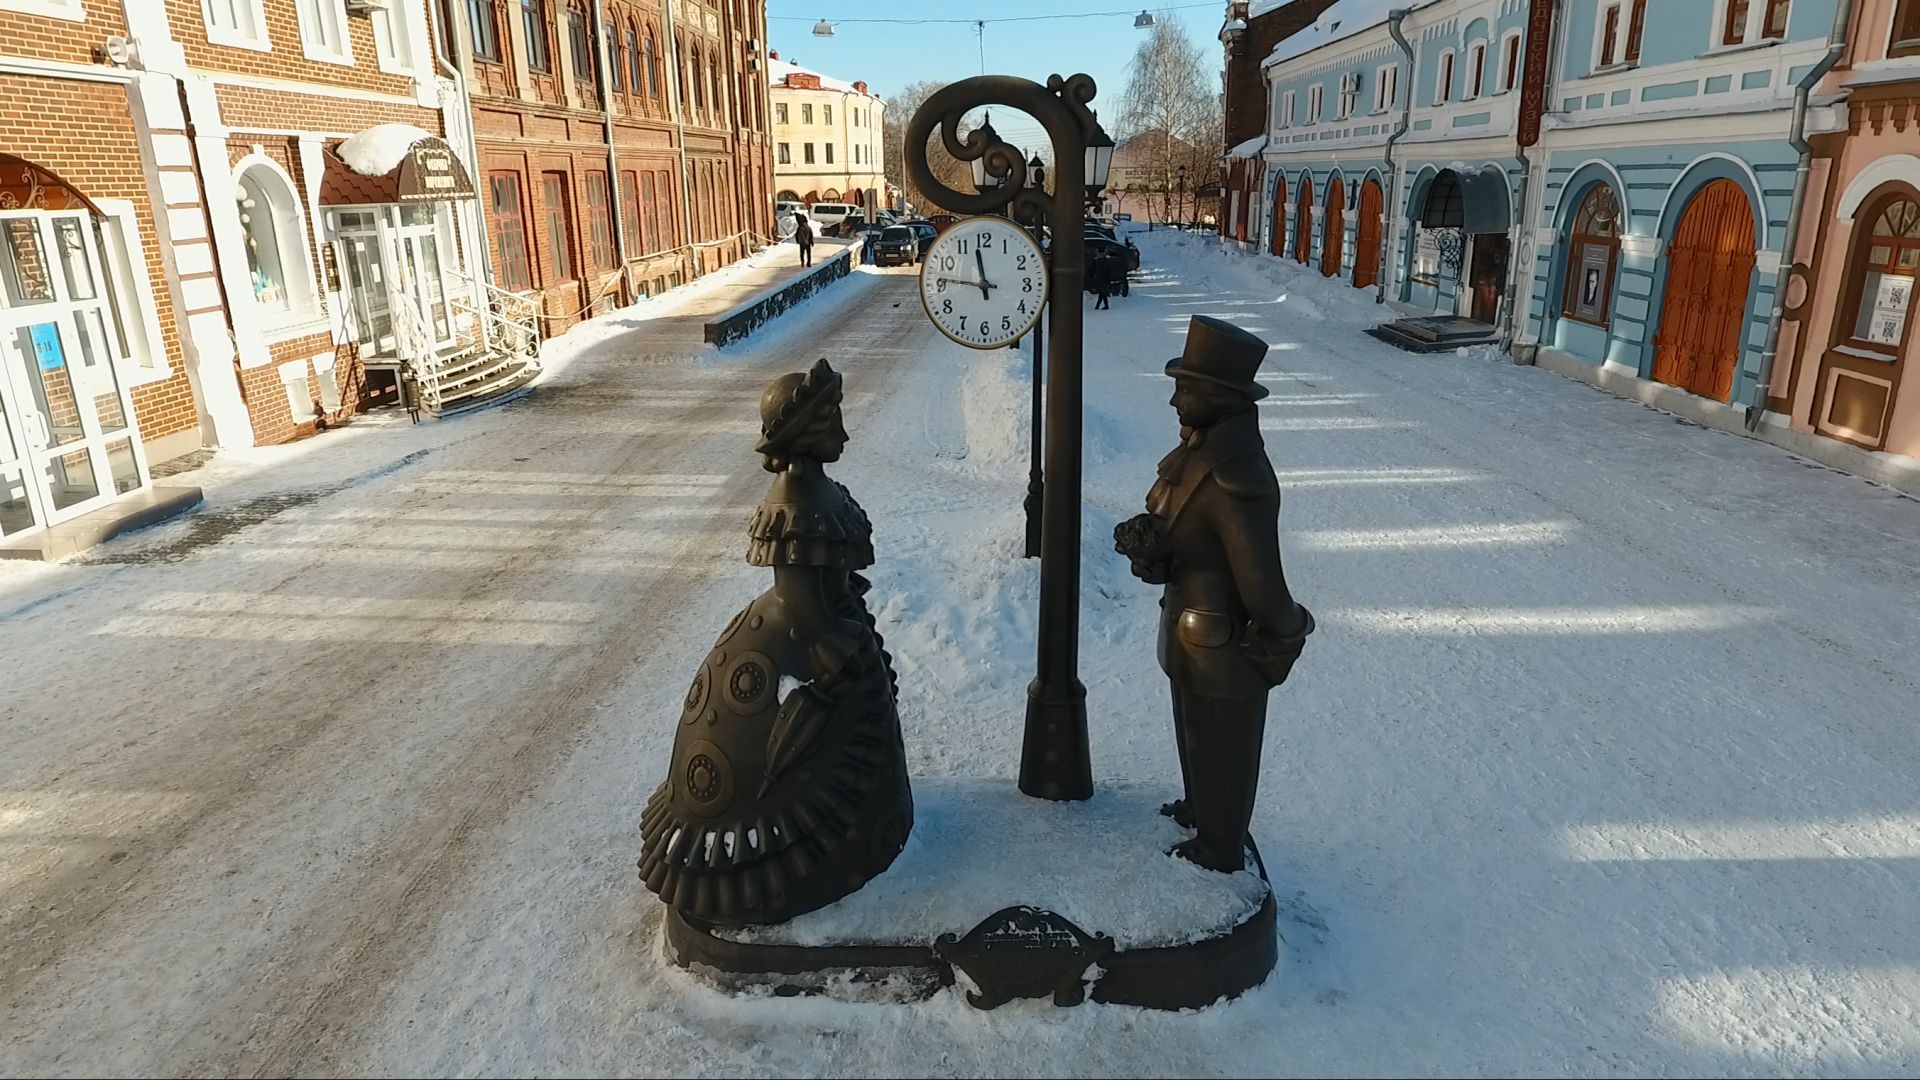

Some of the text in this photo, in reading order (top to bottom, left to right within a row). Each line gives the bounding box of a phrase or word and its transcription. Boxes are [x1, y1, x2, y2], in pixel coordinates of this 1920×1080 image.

[1523, 90, 1540, 141] МУЗЕЙ
[957, 239, 968, 255] 11
[976, 232, 992, 248] 12
[1002, 239, 1008, 255] 1
[940, 256, 955, 271] 10
[1016, 255, 1027, 271] 2
[936, 277, 947, 293] 9
[1022, 277, 1033, 293] 3
[942, 299, 953, 314] 8
[1017, 299, 1026, 314] 4
[959, 315, 968, 331] 7
[980, 321, 990, 336] 6
[1001, 315, 1011, 330] 5
